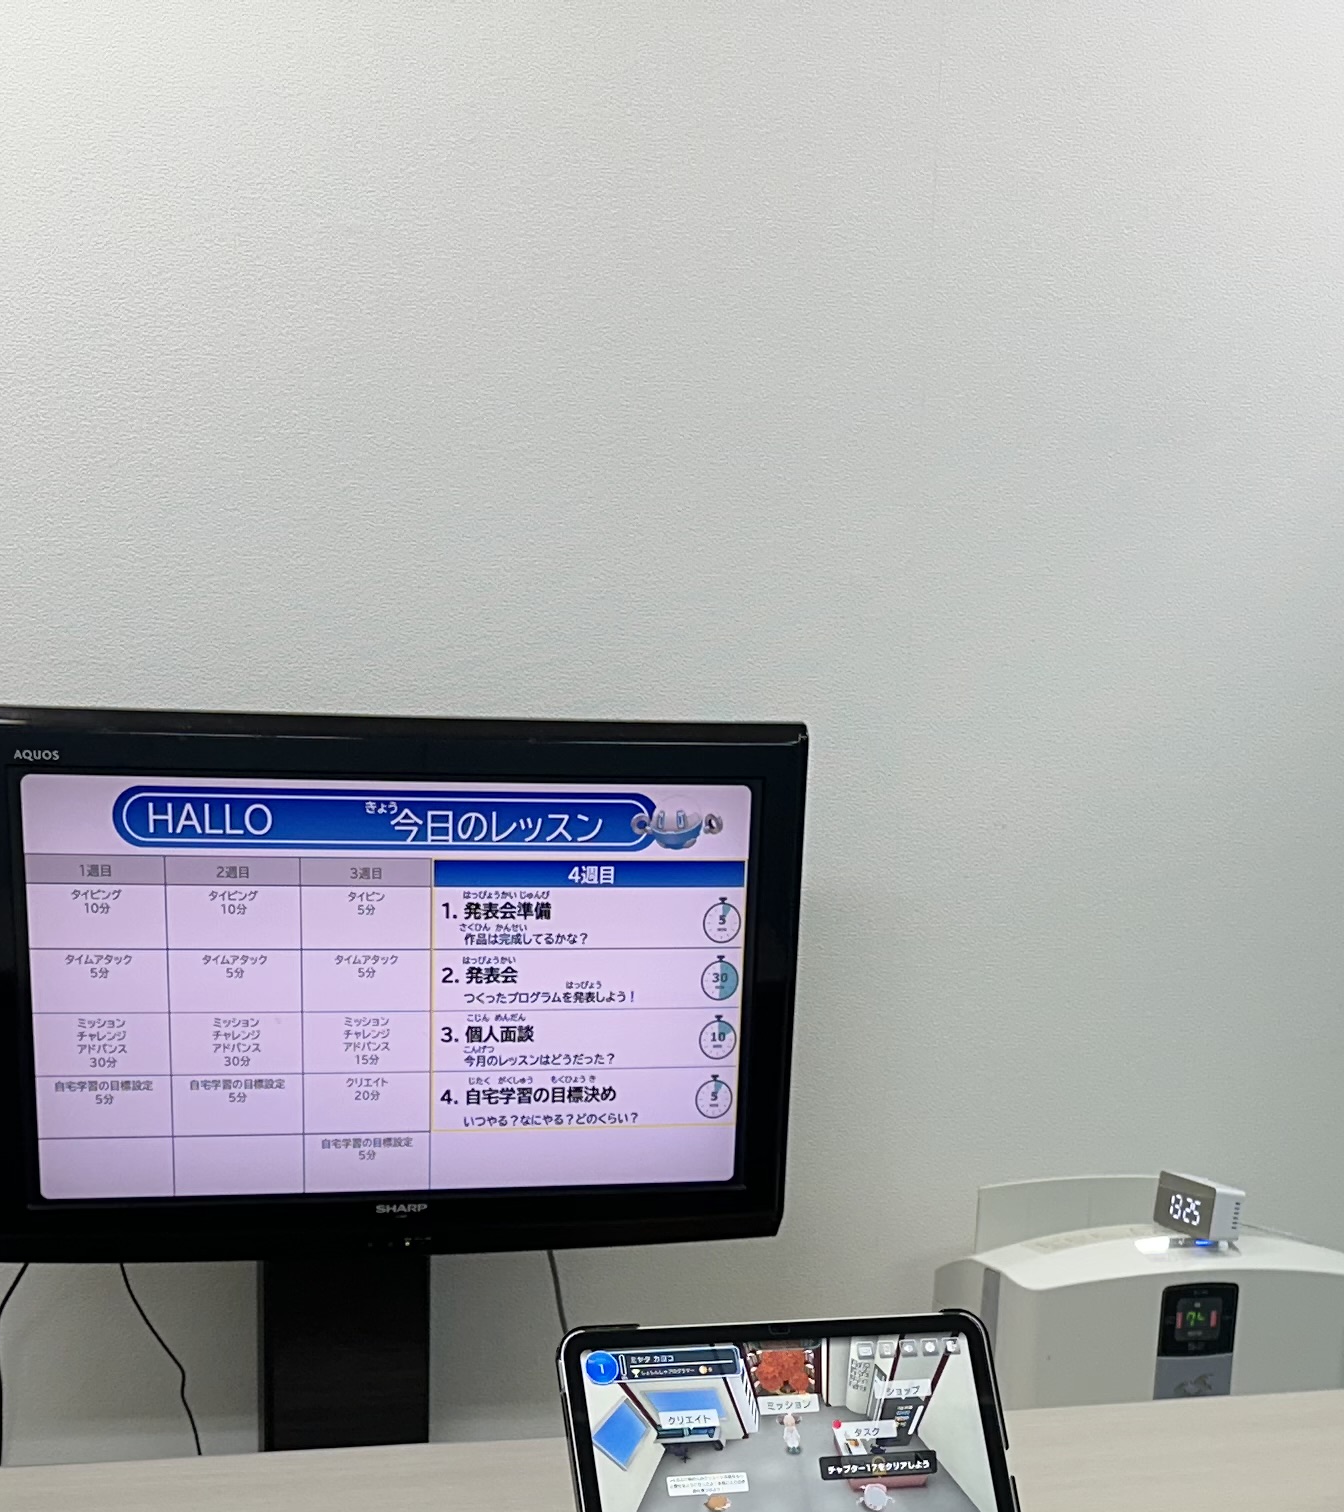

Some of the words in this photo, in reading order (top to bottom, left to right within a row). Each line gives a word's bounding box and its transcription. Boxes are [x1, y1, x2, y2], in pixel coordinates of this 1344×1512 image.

[13, 749, 60, 761] AQUOS
[365, 801, 398, 815] きょう
[148, 802, 273, 836] HALLO
[390, 808, 604, 843] 今日のレッスン
[78, 864, 112, 878] 1週目
[216, 865, 250, 880] 2週目
[350, 867, 383, 881] 3週目
[568, 866, 615, 885] 4週目
[71, 888, 122, 901] タイピング
[208, 890, 258, 902] タイピング
[347, 891, 386, 903] タイピン
[84, 902, 111, 915] 10分
[220, 903, 247, 916] 10分
[357, 904, 376, 916] 5分
[441, 902, 458, 920] 1.
[464, 902, 552, 921] 発表会準備
[718, 914, 726, 926] 5
[64, 953, 133, 966] タイムアタック
[201, 953, 268, 966] タイムアタック
[334, 953, 399, 966] タイムアタック
[89, 967, 110, 979] 5分
[225, 967, 245, 979] 5分
[357, 967, 377, 979] 5分
[441, 968, 459, 984] 2.
[465, 966, 518, 985] 発表会
[712, 972, 728, 983] 30
[77, 1018, 126, 1029] ミッション
[212, 1017, 260, 1028] ミッション
[344, 1016, 390, 1028] ミッション
[77, 1030, 127, 1042] チャレンジ
[212, 1029, 261, 1041] チャレンジ
[343, 1028, 390, 1040] チャレンジ
[440, 1026, 459, 1043] 3.
[465, 1025, 535, 1043] 個人面談
[711, 1031, 726, 1042] 10
[77, 1043, 128, 1055] アドバンス
[212, 1042, 261, 1054] アドバンス
[343, 1041, 390, 1053] アドバンス
[89, 1057, 118, 1069] 30分
[223, 1055, 251, 1068] 30分
[354, 1054, 380, 1066] 15分
[54, 1079, 154, 1092] 自宅学習の目標設定
[189, 1078, 286, 1091] 自宅学習の目標設定
[345, 1077, 389, 1088] クリエイト
[95, 1093, 115, 1105] 5分
[228, 1091, 248, 1103] 5分
[354, 1089, 381, 1101] 20分
[440, 1089, 459, 1105] 4.
[465, 1087, 617, 1105] 自宅学習の目標決め
[709, 1091, 718, 1102] 5
[321, 1136, 414, 1150] 自宅学習の目標設定
[358, 1150, 377, 1162] 5分
[375, 1203, 428, 1214] SHARP
[885, 1385, 921, 1397] ショップ
[766, 1399, 812, 1411] ミッション
[667, 1414, 712, 1426] クリエイト
[854, 1427, 881, 1437] タスク
